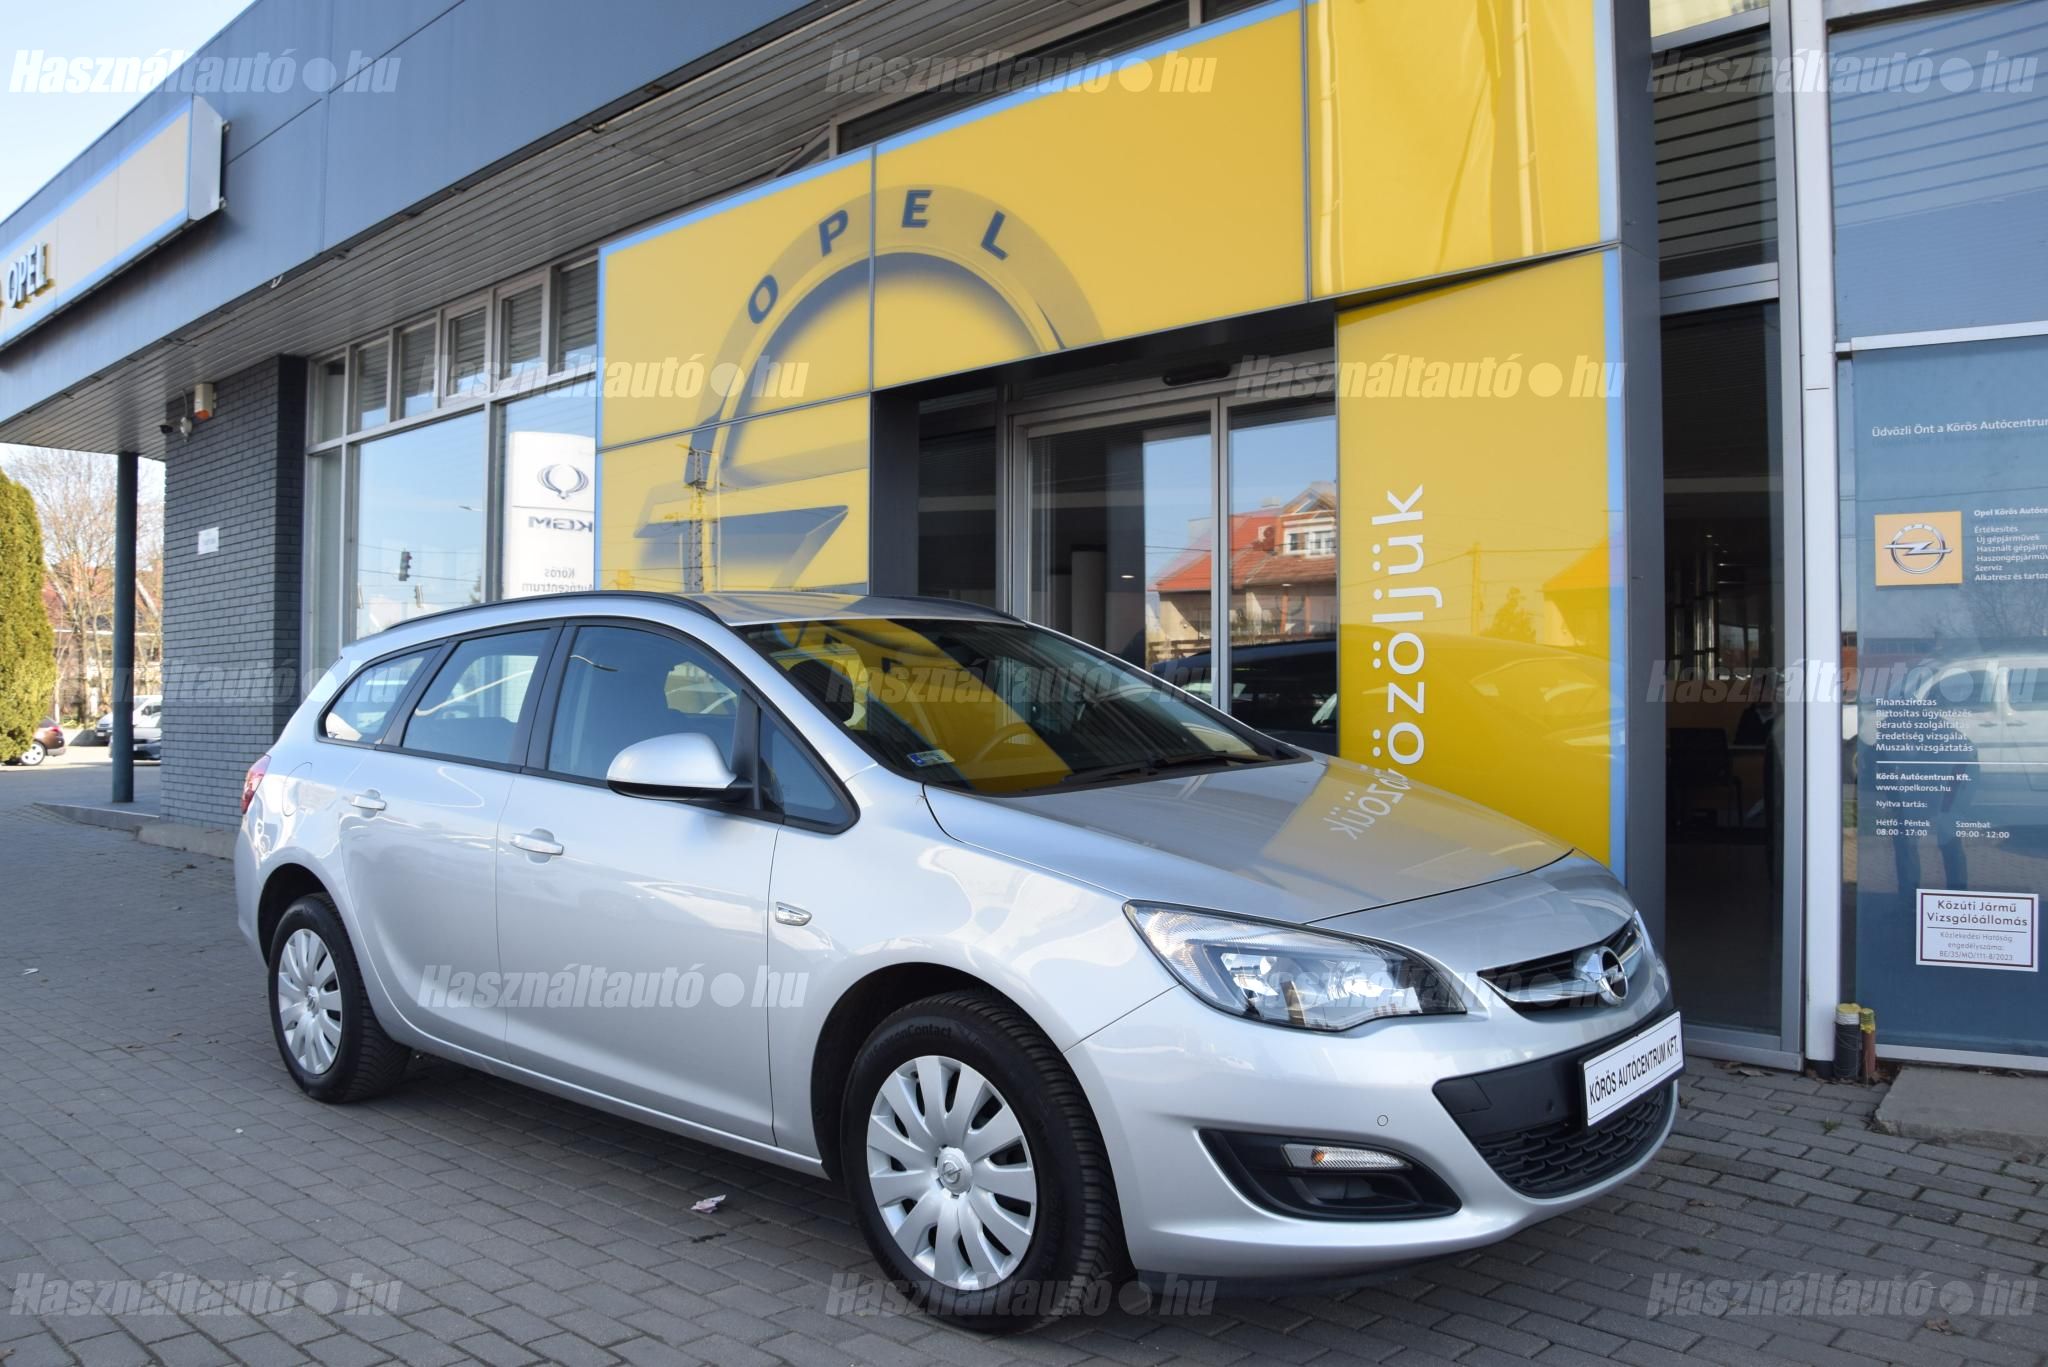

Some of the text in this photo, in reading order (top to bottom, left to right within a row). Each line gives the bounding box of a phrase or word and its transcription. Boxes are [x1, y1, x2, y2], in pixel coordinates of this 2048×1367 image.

[748, 189, 1009, 325] OPEL
[7, 241, 49, 308] OPEL
[1914, 422, 1935, 434] Önt
[1937, 425, 1944, 434] a
[1974, 509, 1993, 518] Opel
[1976, 544, 2048, 553] Használt gépjárm
[1371, 484, 1443, 774] özöljük
[1876, 720, 1912, 729] Bérautó
[1876, 732, 1924, 742] Eredetiség
[1916, 743, 1974, 754] vizsgáztatás
[1900, 772, 1955, 782] Autócentrum
[1956, 773, 1972, 782] Kft.
[1876, 784, 1951, 793] www.opelkoros.hu
[1876, 800, 1928, 809] Nyitva tartás:
[1904, 819, 1930, 828] Péntek
[1956, 820, 1992, 829] Szombat
[1876, 828, 1899, 836] 08:00
[1905, 829, 1928, 837] 17:00
[1956, 830, 1980, 838] 09:00
[1986, 831, 2010, 839] 12:00
[1927, 911, 2028, 926] Vizsgálóállomás
[1618, 1044, 1667, 1089] AUTÓCENTRUM
[1667, 1034, 1679, 1058] KFT.
